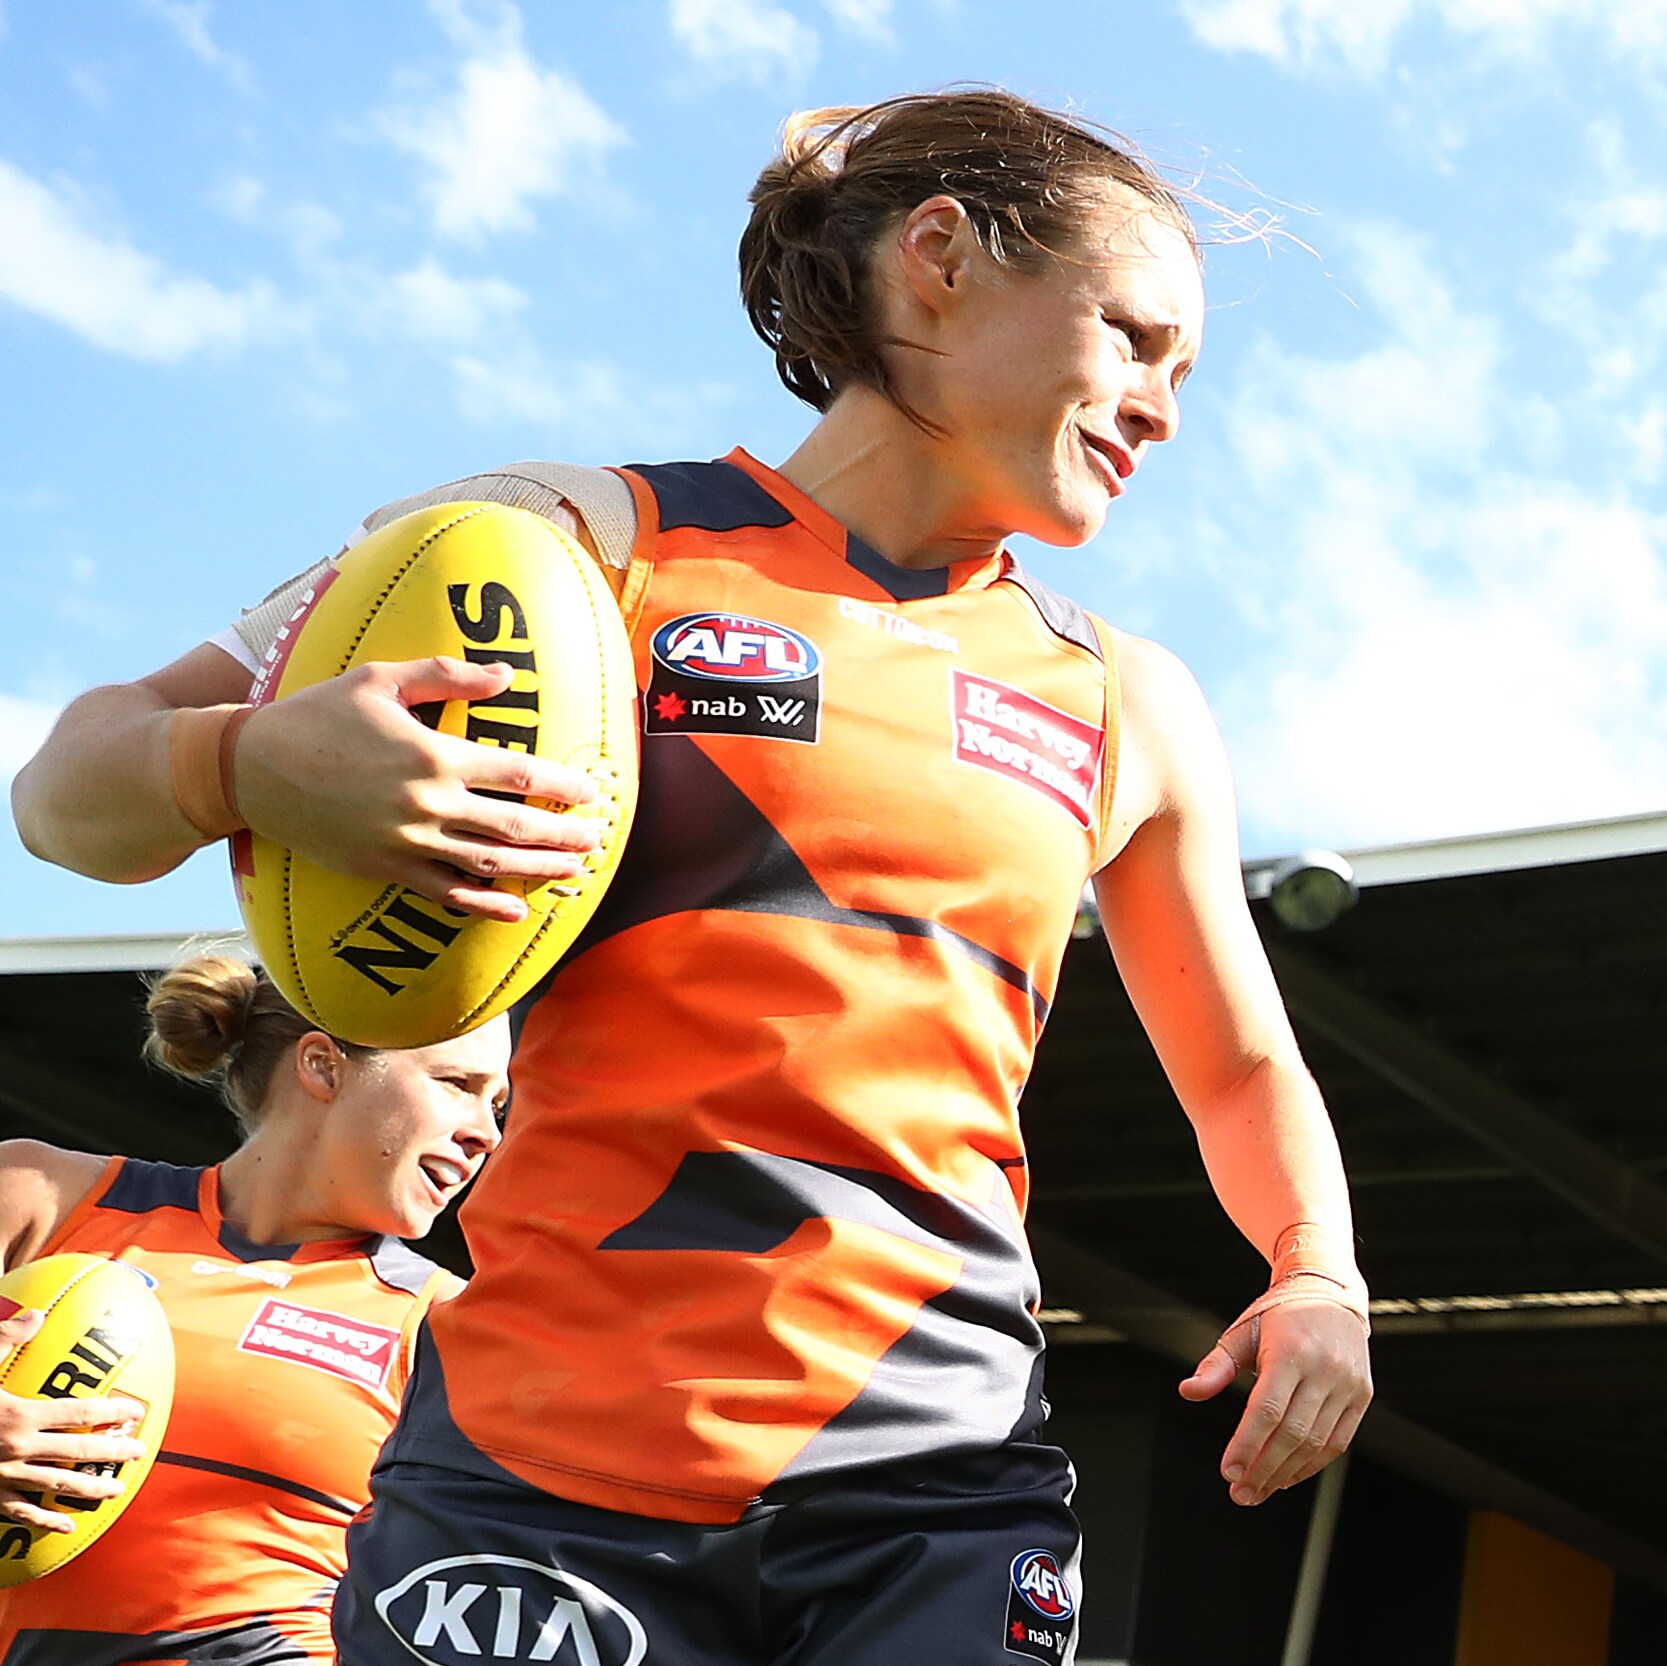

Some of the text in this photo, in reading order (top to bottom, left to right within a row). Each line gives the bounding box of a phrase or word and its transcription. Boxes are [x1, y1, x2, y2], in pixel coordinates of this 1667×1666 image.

[666, 628, 809, 674] AFL
[691, 697, 747, 718] nab
[964, 681, 1092, 771] Harvey
[246, 1324, 383, 1386] Norman
[265, 1305, 390, 1356] Harvey
[1019, 1559, 1072, 1611] AFL
[1027, 1628, 1053, 1648] nab
